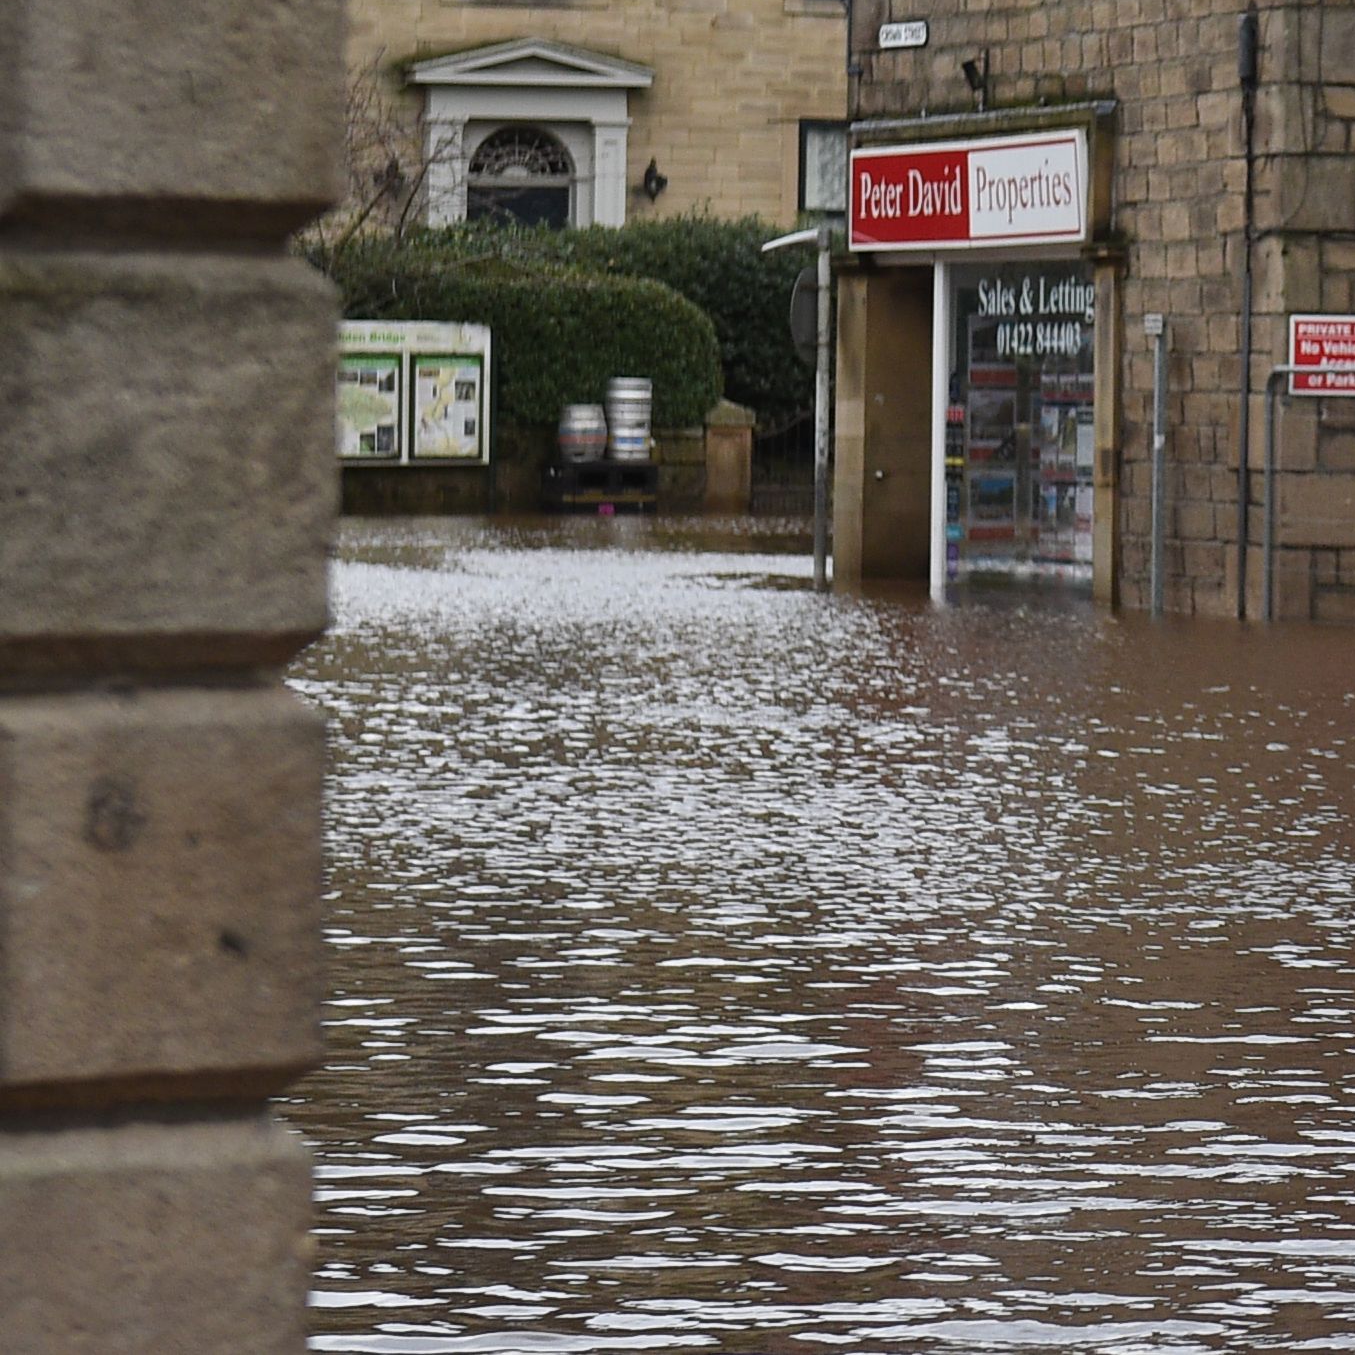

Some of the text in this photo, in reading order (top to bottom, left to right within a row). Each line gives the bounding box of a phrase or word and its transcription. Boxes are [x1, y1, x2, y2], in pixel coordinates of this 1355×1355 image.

[860, 159, 1072, 224] Peter David Properties
[978, 278, 1015, 317] Sales
[1019, 275, 1034, 315] &
[996, 321, 1081, 357] 01422 844403
[1298, 324, 1351, 336] PRIVATE
[1301, 340, 1320, 355] No
[1308, 374, 1322, 386] or
